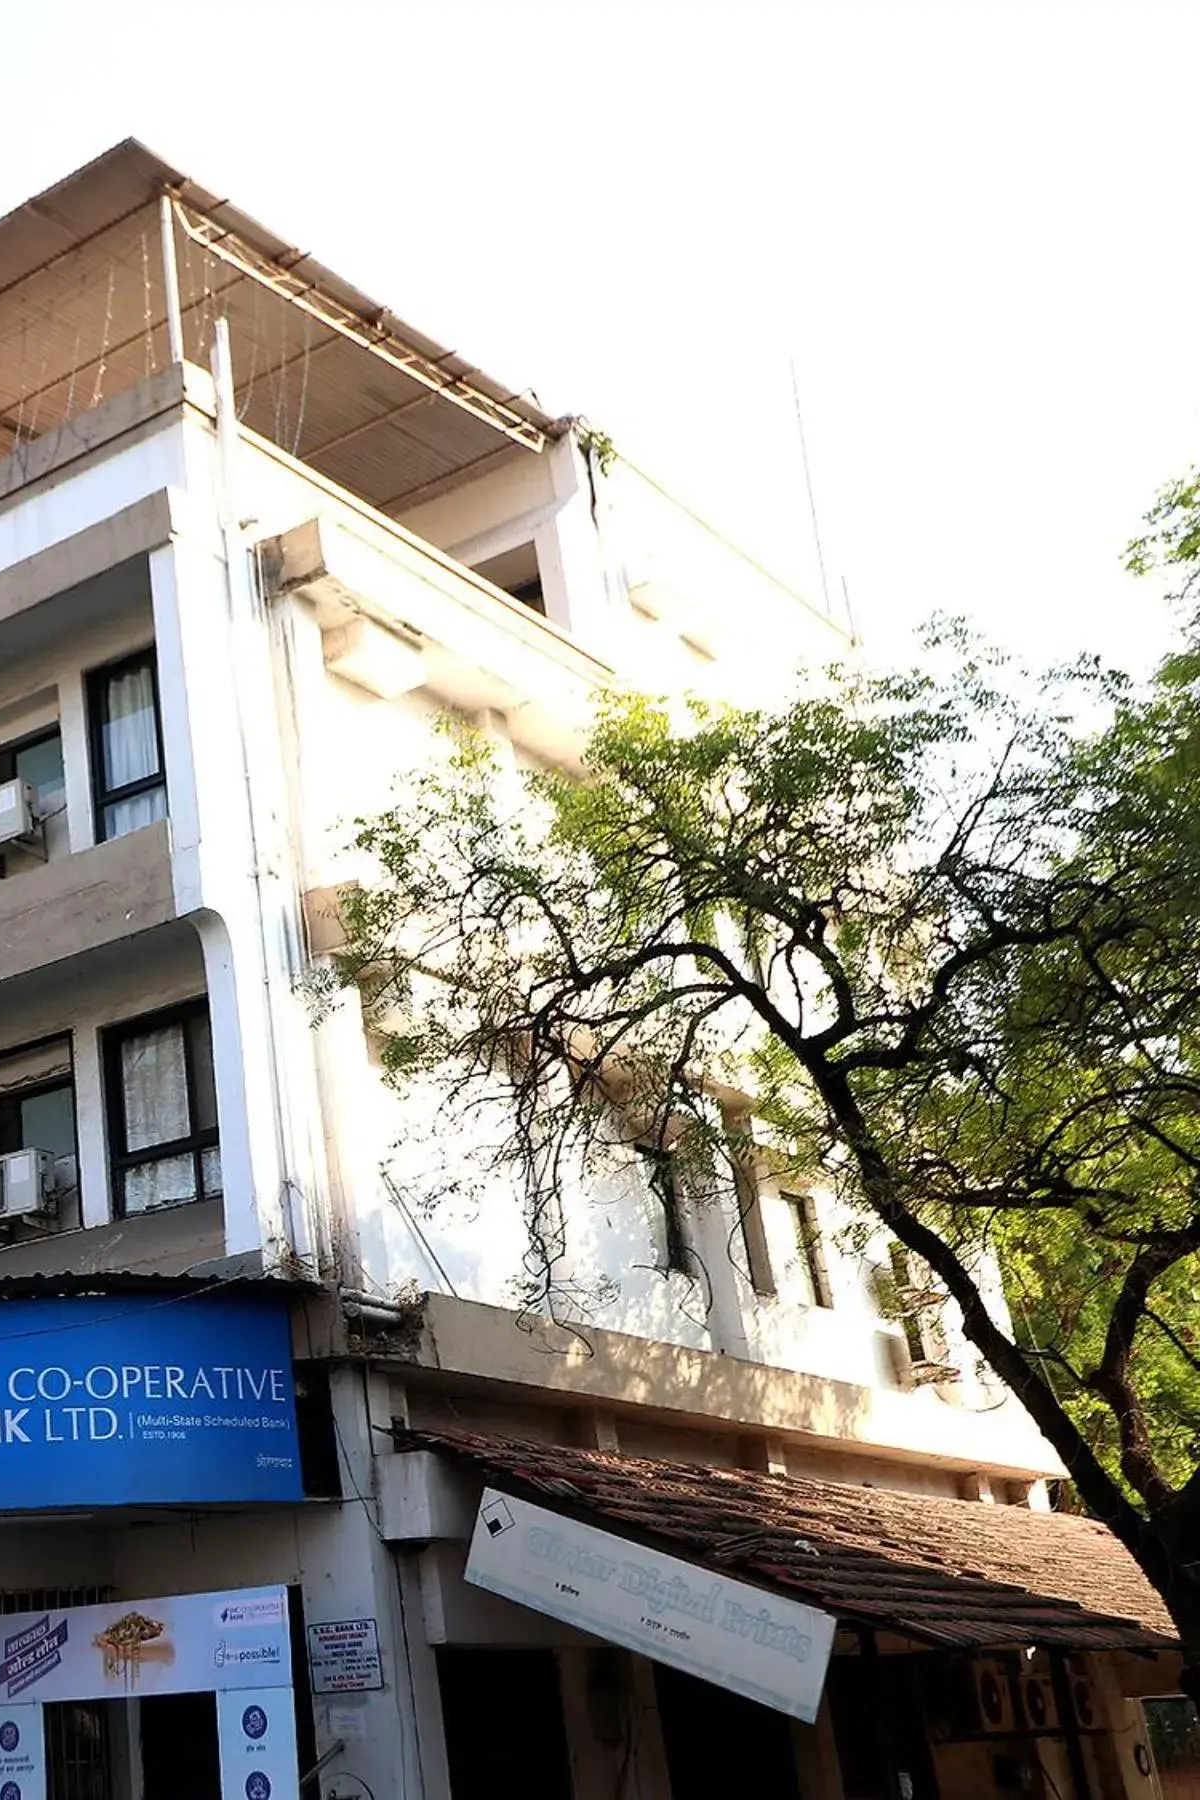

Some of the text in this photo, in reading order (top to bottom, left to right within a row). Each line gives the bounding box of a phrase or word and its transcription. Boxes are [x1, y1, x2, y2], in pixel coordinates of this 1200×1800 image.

[7, 1366, 286, 1402] CO-OPERATIVE
[45, 1406, 123, 1442] LTD.
[137, 1413, 290, 1431] (Multi-State Scheduled Bank)
[619, 1561, 722, 1624] Digital
[721, 1598, 814, 1663] Prints
